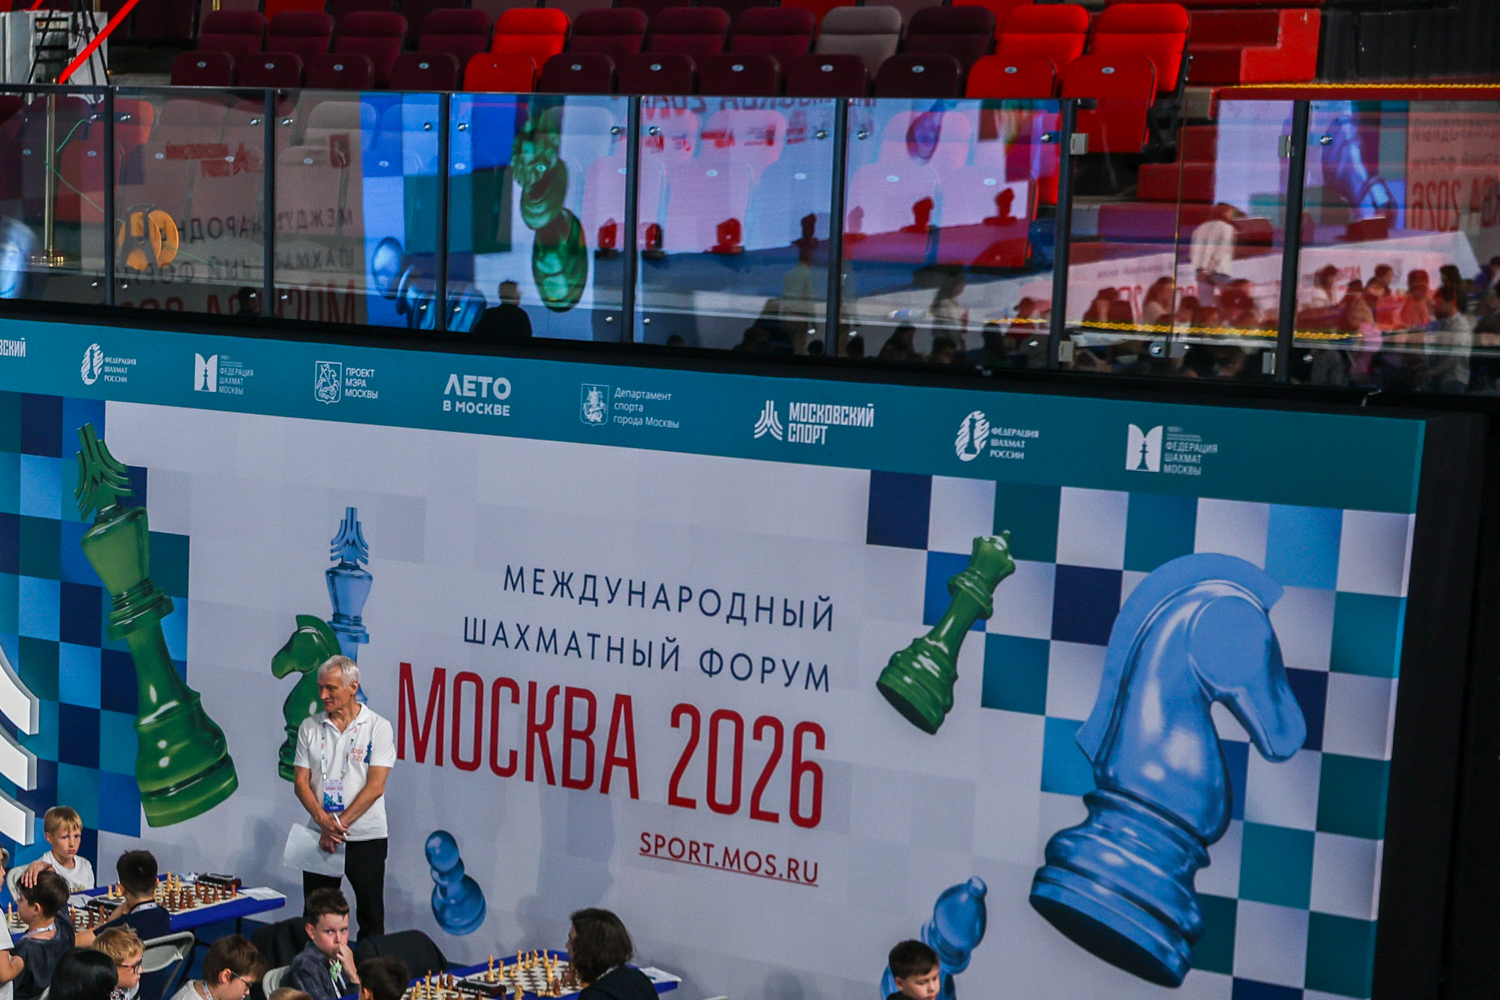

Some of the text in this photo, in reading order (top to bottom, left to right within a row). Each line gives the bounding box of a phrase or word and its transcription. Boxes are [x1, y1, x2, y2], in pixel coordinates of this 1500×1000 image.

[220, 368, 254, 378] ФЕДЕРАЦИЯ
[345, 367, 375, 379] ПРОЕКТ
[219, 377, 244, 386] ШАХМАТ
[345, 378, 367, 389] МЭРА
[444, 373, 512, 400] ЛЕТО
[219, 386, 244, 395] МОСКВЫ
[345, 388, 379, 400] МОСКВЫ
[614, 387, 672, 401] Департамент
[443, 400, 510, 417] В МОСКВЕ
[614, 402, 644, 413] спорта
[613, 415, 680, 429] города Москвы
[789, 402, 874, 428] МОСКОВСКИЙ
[788, 423, 828, 445] СПОРТ
[503, 564, 833, 632] МЕЖДУНАРОДНЫЙ
[463, 616, 830, 693] ШАХМАТНЫЙ ФОРУМ
[397, 661, 826, 829] МОСКВА 2026
[640, 831, 818, 885] SPORT.MOS.RU
